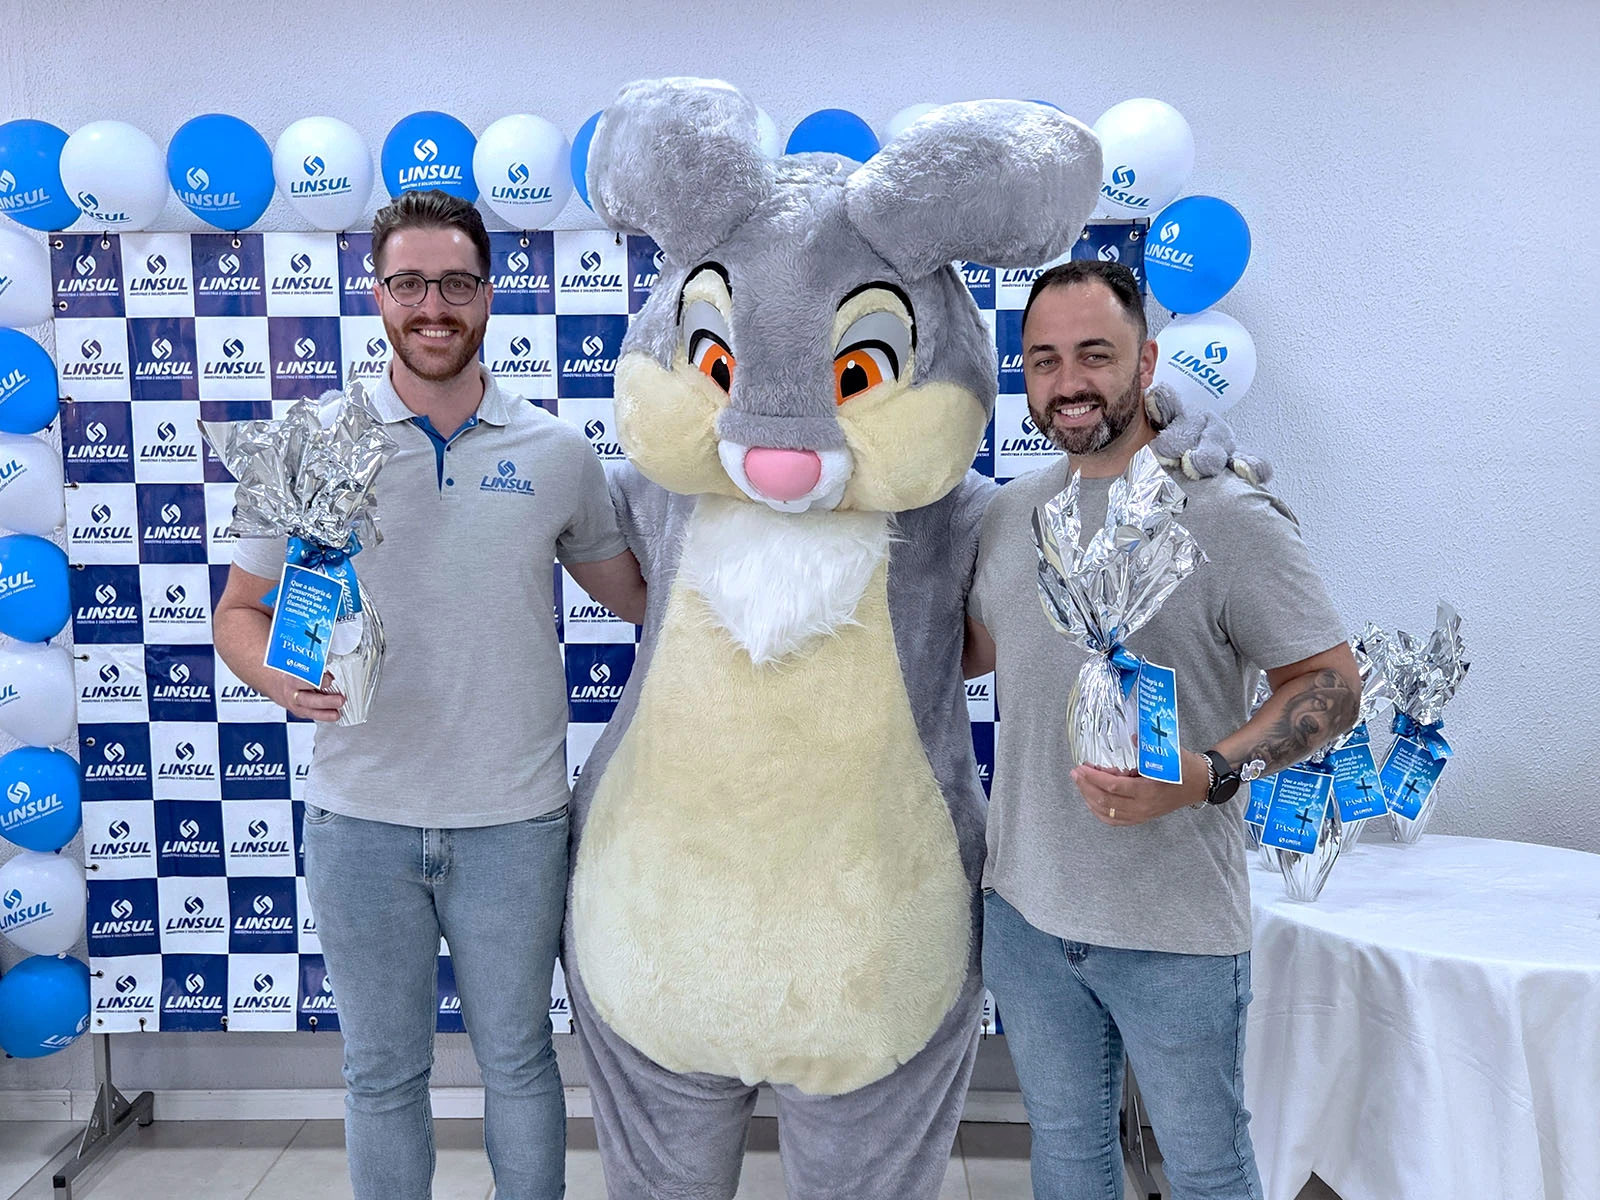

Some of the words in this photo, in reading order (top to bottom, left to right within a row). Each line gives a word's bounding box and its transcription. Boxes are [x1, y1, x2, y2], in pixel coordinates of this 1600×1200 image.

[399, 164, 463, 184] LINSUL
[291, 177, 351, 193] LINSUL
[178, 188, 240, 207] LINSUL
[491, 186, 552, 199] LINSUL
[1145, 242, 1194, 267] LINSUL
[57, 278, 119, 292] LINSUL
[129, 278, 188, 291] LINSUL
[199, 277, 261, 290] LINSUL
[271, 277, 333, 290] LINSUL
[560, 275, 623, 288] LINSUL
[63, 362, 124, 375] LINSUL
[136, 362, 193, 375] LINSUL
[203, 362, 265, 374] LINSUL
[276, 361, 337, 374] LINSUL
[490, 361, 552, 373] LINSUL
[1171, 350, 1231, 395] LINSUL
[67, 445, 128, 458] LINSUL
[140, 446, 197, 457] LINSUL
[480, 476, 534, 492] LINSUL
[72, 527, 133, 539] LINSUL
[144, 527, 201, 539] LINSUL
[77, 606, 137, 619] LINSUL
[149, 607, 206, 619] LINSUL
[282, 640, 317, 661] PÁSCOA
[82, 686, 142, 698] LINSUL
[153, 686, 210, 697] LINSUL
[85, 765, 146, 776] LINSUL
[158, 764, 215, 775] LINSUL
[225, 764, 286, 776] LINSUL
[1, 793, 62, 827] LINSUL
[90, 842, 150, 854] LINSUL
[162, 841, 219, 853] LINSUL
[231, 842, 289, 853] LINSUL
[92, 920, 154, 934] LINSUL
[166, 918, 224, 929] LINSUL
[234, 918, 293, 929] LINSUL
[97, 997, 154, 1008] LINSUL
[165, 996, 222, 1008] LINSUL
[233, 997, 291, 1008] LINSUL
